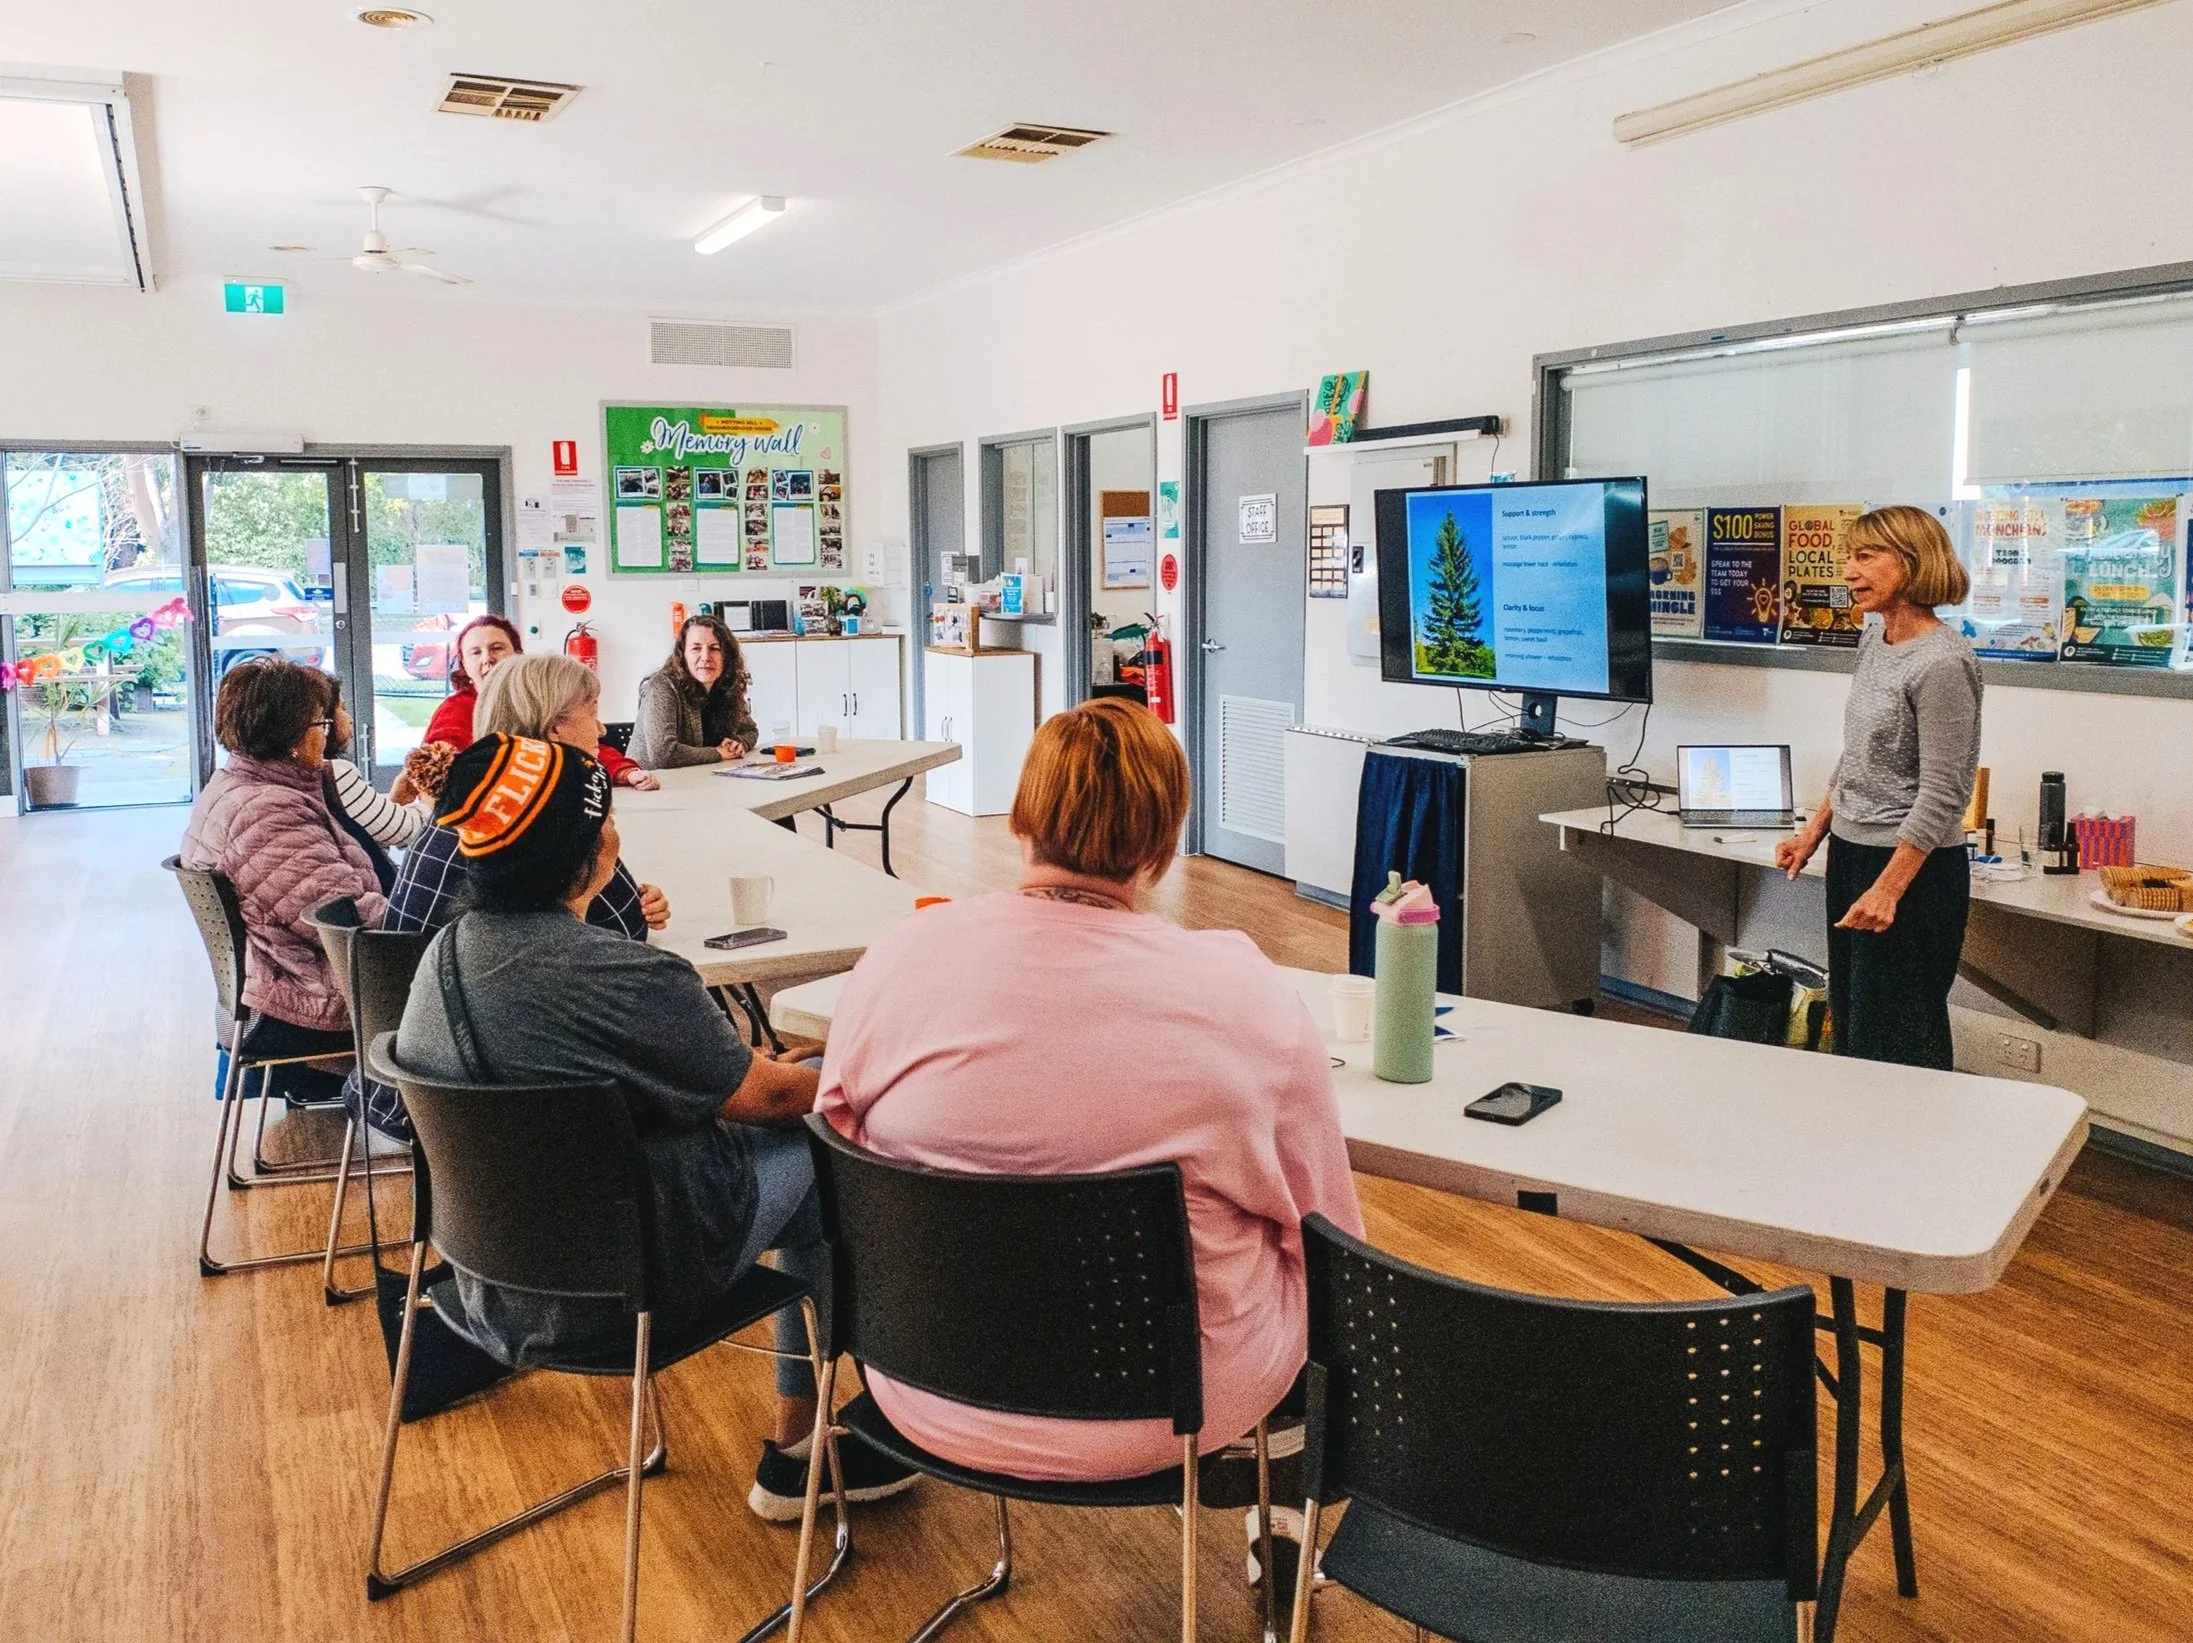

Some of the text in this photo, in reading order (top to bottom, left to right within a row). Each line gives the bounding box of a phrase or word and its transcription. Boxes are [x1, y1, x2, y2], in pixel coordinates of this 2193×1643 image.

[653, 419, 803, 465] Memory wall
[1248, 504, 1267, 518] STAFF
[1502, 509, 1525, 518] Support
[1531, 508, 1556, 517] strength
[1754, 512, 1775, 520] POWER
[1247, 521, 1269, 534] OFFICE
[1713, 514, 1753, 539] $100
[1754, 521, 1775, 529] SAVING
[1788, 520, 1836, 531] GLOBAL
[1788, 533, 1836, 549] FOOD,
[1788, 550, 1834, 564] LOCAL
[1711, 560, 1753, 568] SPEAK TO THE
[1711, 569, 1748, 577] TEAM TODAY
[1788, 565, 1834, 578] PLATES
[1503, 604, 1521, 613] Clarity
[1528, 604, 1544, 612] focus
